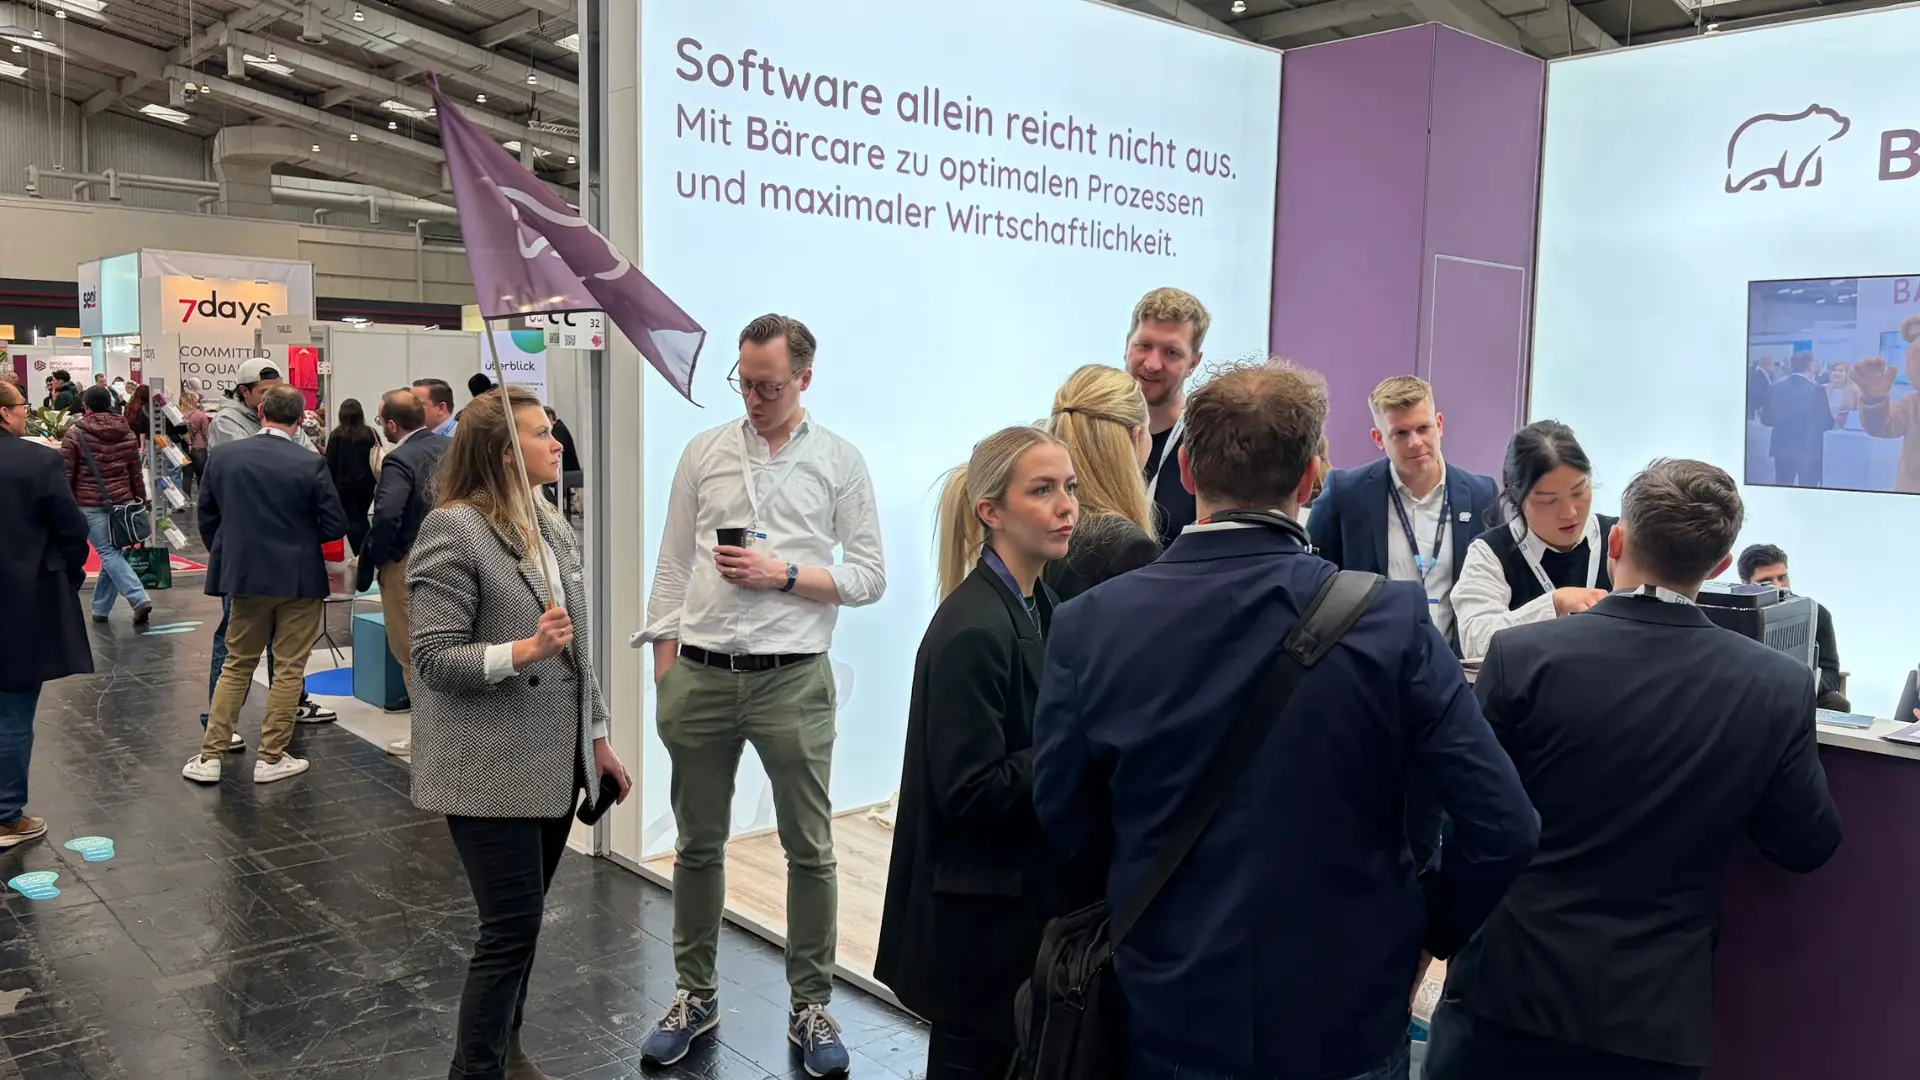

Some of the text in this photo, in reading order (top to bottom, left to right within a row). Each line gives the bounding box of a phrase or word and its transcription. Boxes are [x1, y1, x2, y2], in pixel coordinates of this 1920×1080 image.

[676, 37, 1237, 180] Software allein reicht nicht aus.
[677, 103, 1204, 217] Mit Bärcare zu optimalen Prozessen
[676, 169, 1176, 257] und maximaler Wirtschaftlichkeit.
[178, 290, 272, 326] 7days
[590, 318, 600, 328] 32
[180, 345, 271, 360] COMMITTD
[180, 362, 240, 375] TO QUA
[182, 380, 211, 391] AD
